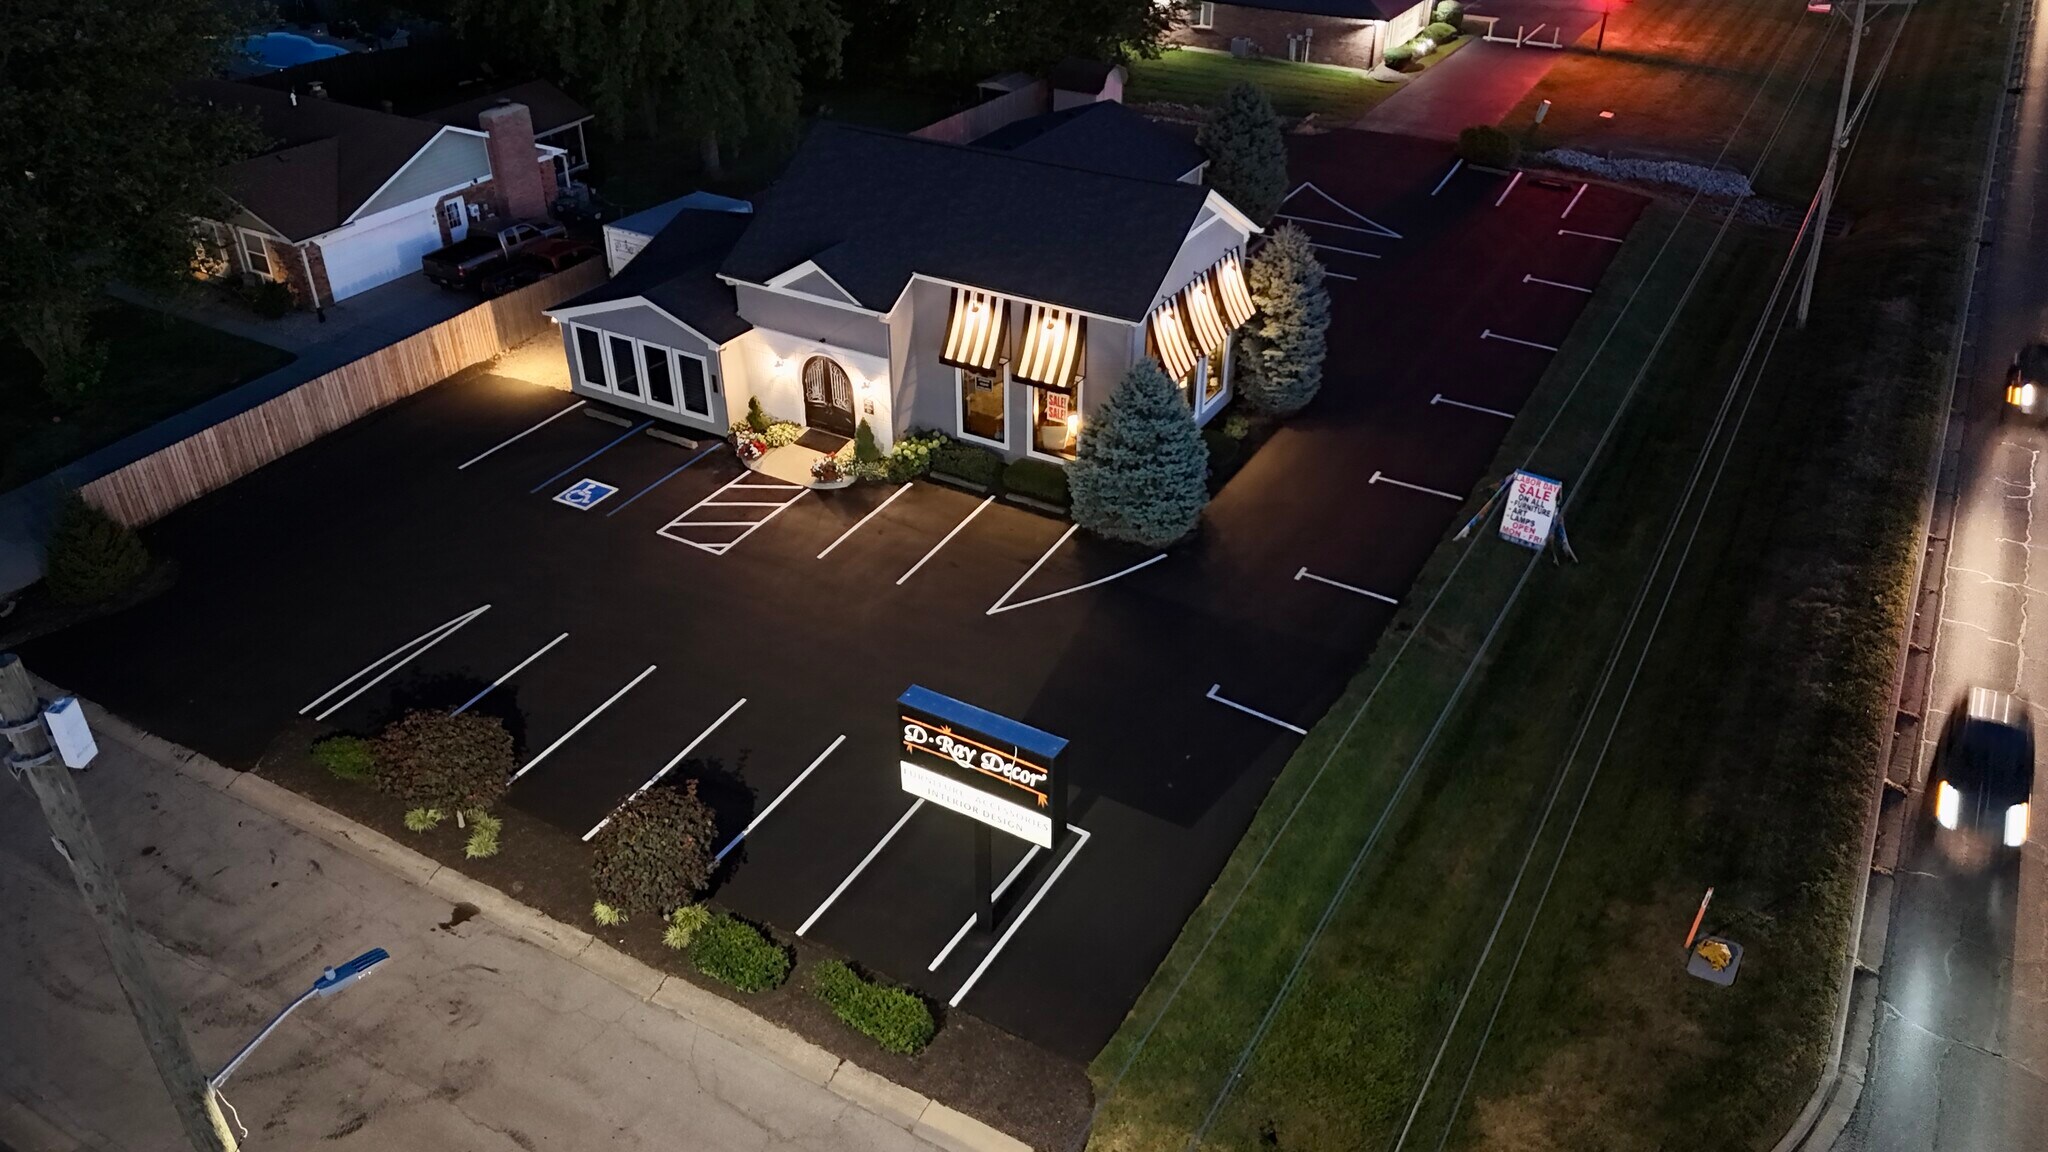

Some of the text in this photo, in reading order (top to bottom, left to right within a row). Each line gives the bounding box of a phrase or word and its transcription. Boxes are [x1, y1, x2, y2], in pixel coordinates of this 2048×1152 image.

[1515, 474, 1557, 493] LABOR DAY
[1518, 484, 1551, 502] SALE
[1518, 494, 1545, 508] ON ALL
[1510, 514, 1535, 527] LAMPS
[1512, 507, 1528, 517] ART
[1503, 526, 1521, 537] MON
[1528, 534, 1543, 543] FRI
[1512, 522, 1536, 534] OPEN
[903, 767, 1049, 831] FURNITURE ACCESSORIES
[927, 788, 1023, 832] INTERIOR DESIGN
